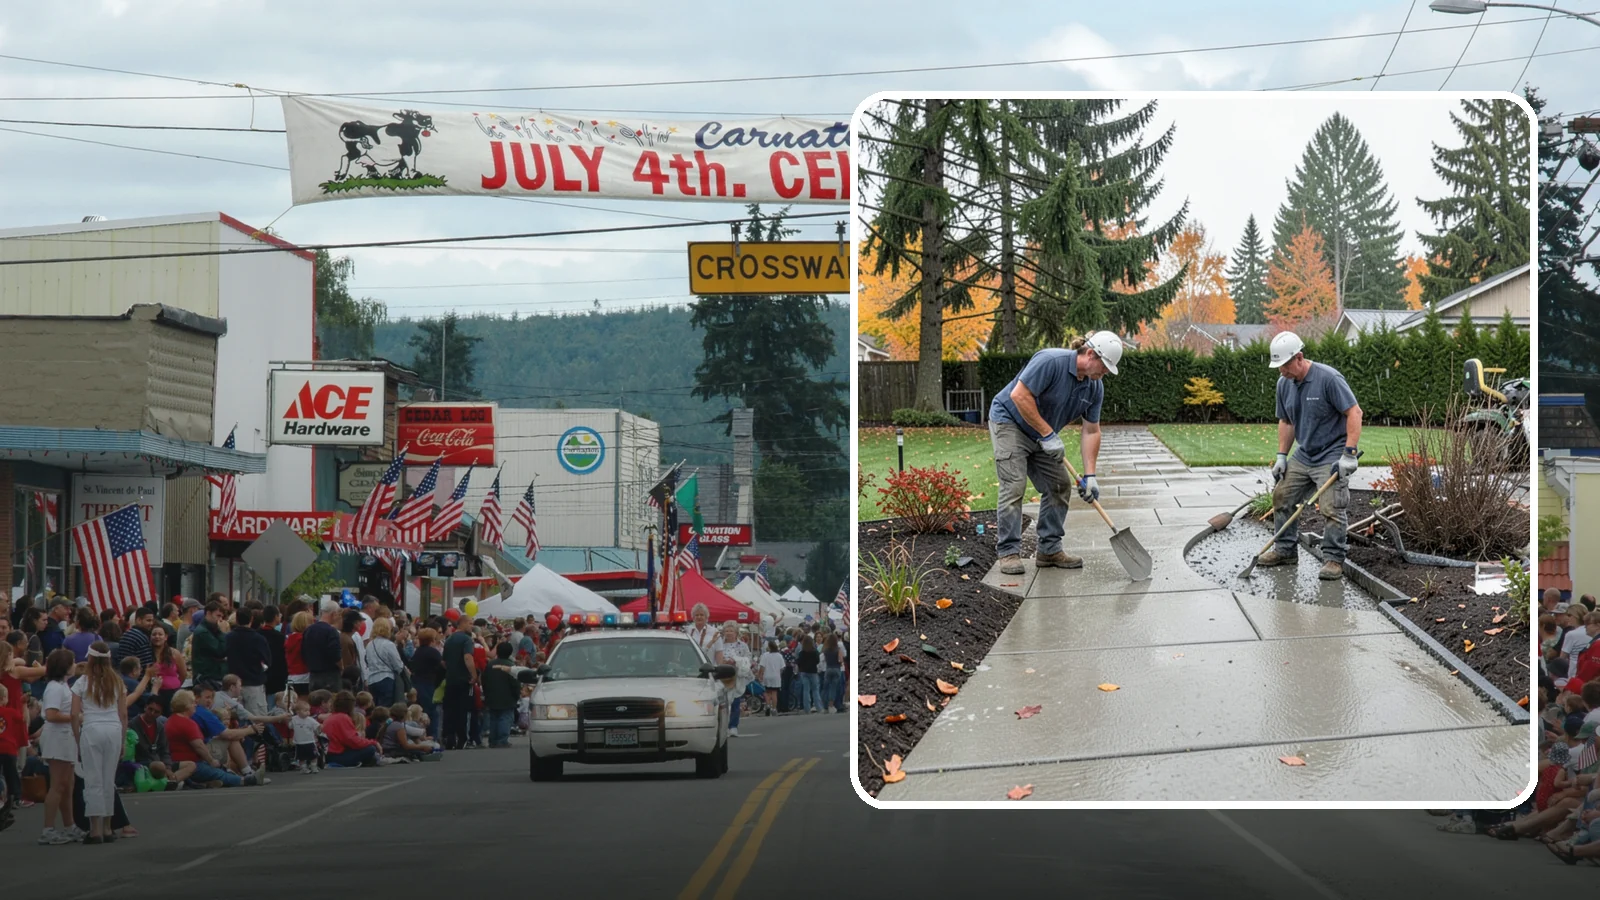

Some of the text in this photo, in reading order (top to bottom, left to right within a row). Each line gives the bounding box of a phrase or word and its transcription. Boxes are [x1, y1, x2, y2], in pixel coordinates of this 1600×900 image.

[481, 140, 604, 193] JULY
[633, 149, 746, 198] 4th.
[697, 254, 849, 280] CROSSWA
[283, 380, 373, 420] ACE
[406, 409, 452, 422] CEDAR
[283, 421, 371, 436] Hardware
[353, 467, 383, 480] Simpl
[83, 485, 155, 495] St. Vincent de Paul
[687, 526, 741, 535] CRNATION
[699, 535, 730, 543] GLASS
